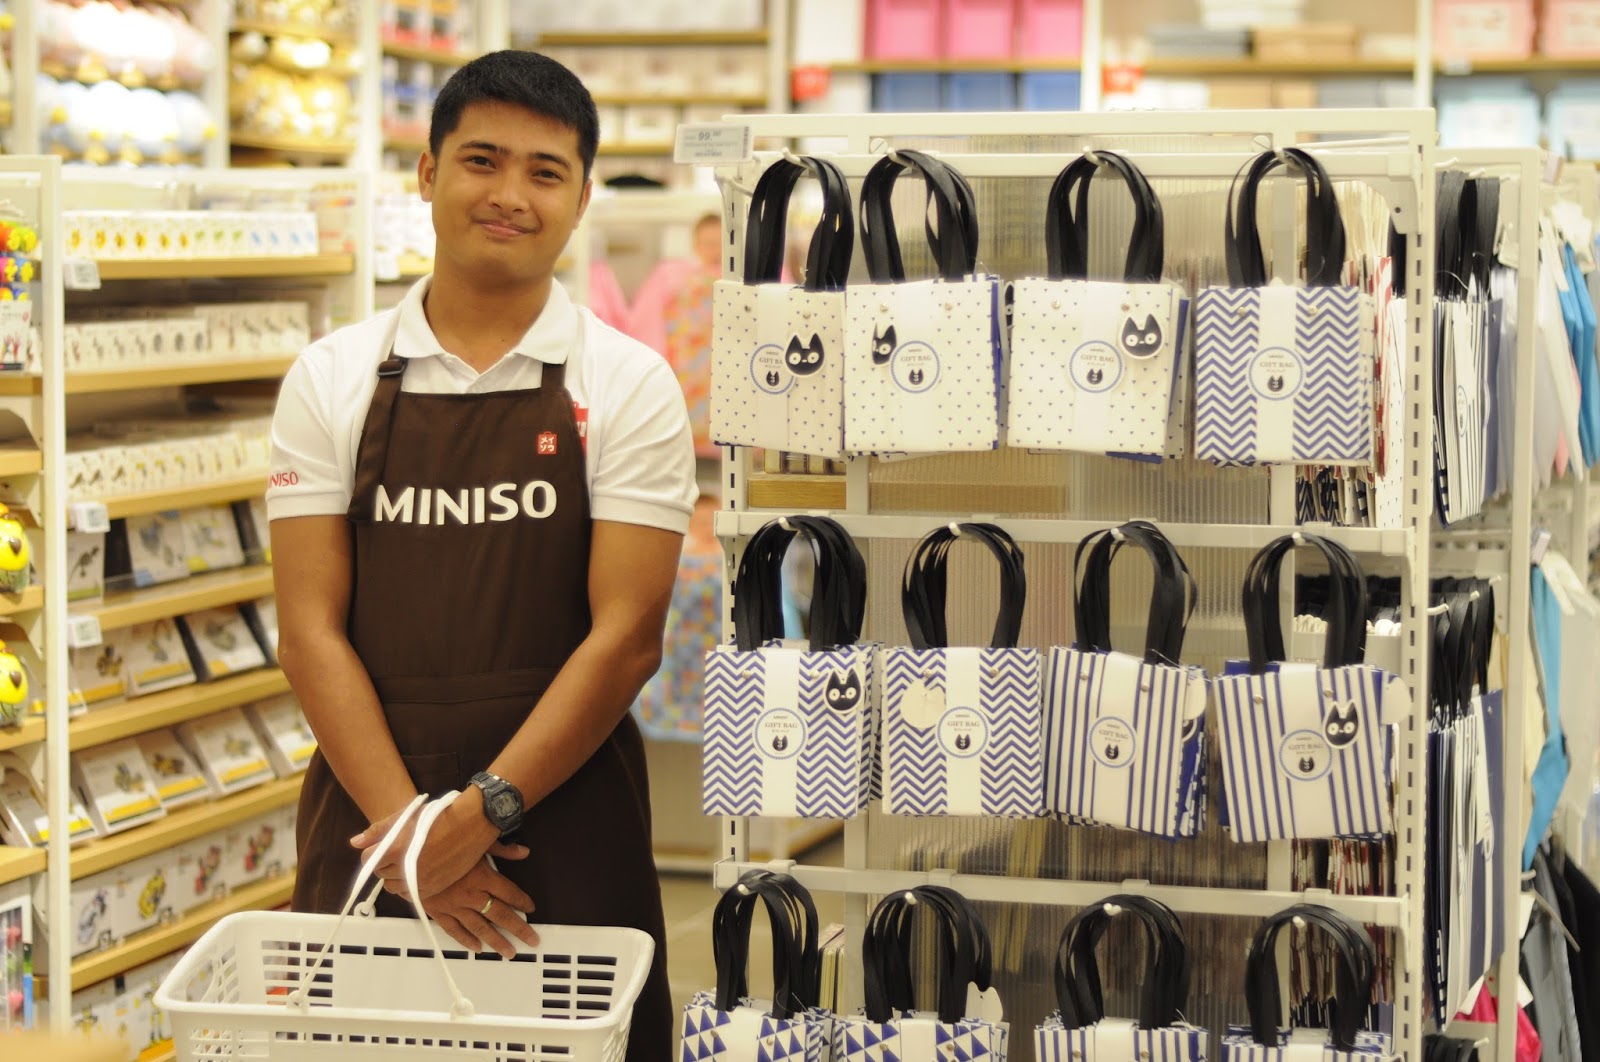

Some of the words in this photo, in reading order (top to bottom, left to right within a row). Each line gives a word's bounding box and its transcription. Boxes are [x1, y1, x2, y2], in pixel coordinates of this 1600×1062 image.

[1080, 354, 1098, 362] GIFT
[375, 480, 557, 525] MINISO
[765, 721, 781, 729] GIFT
[947, 720, 964, 728] GIFT
